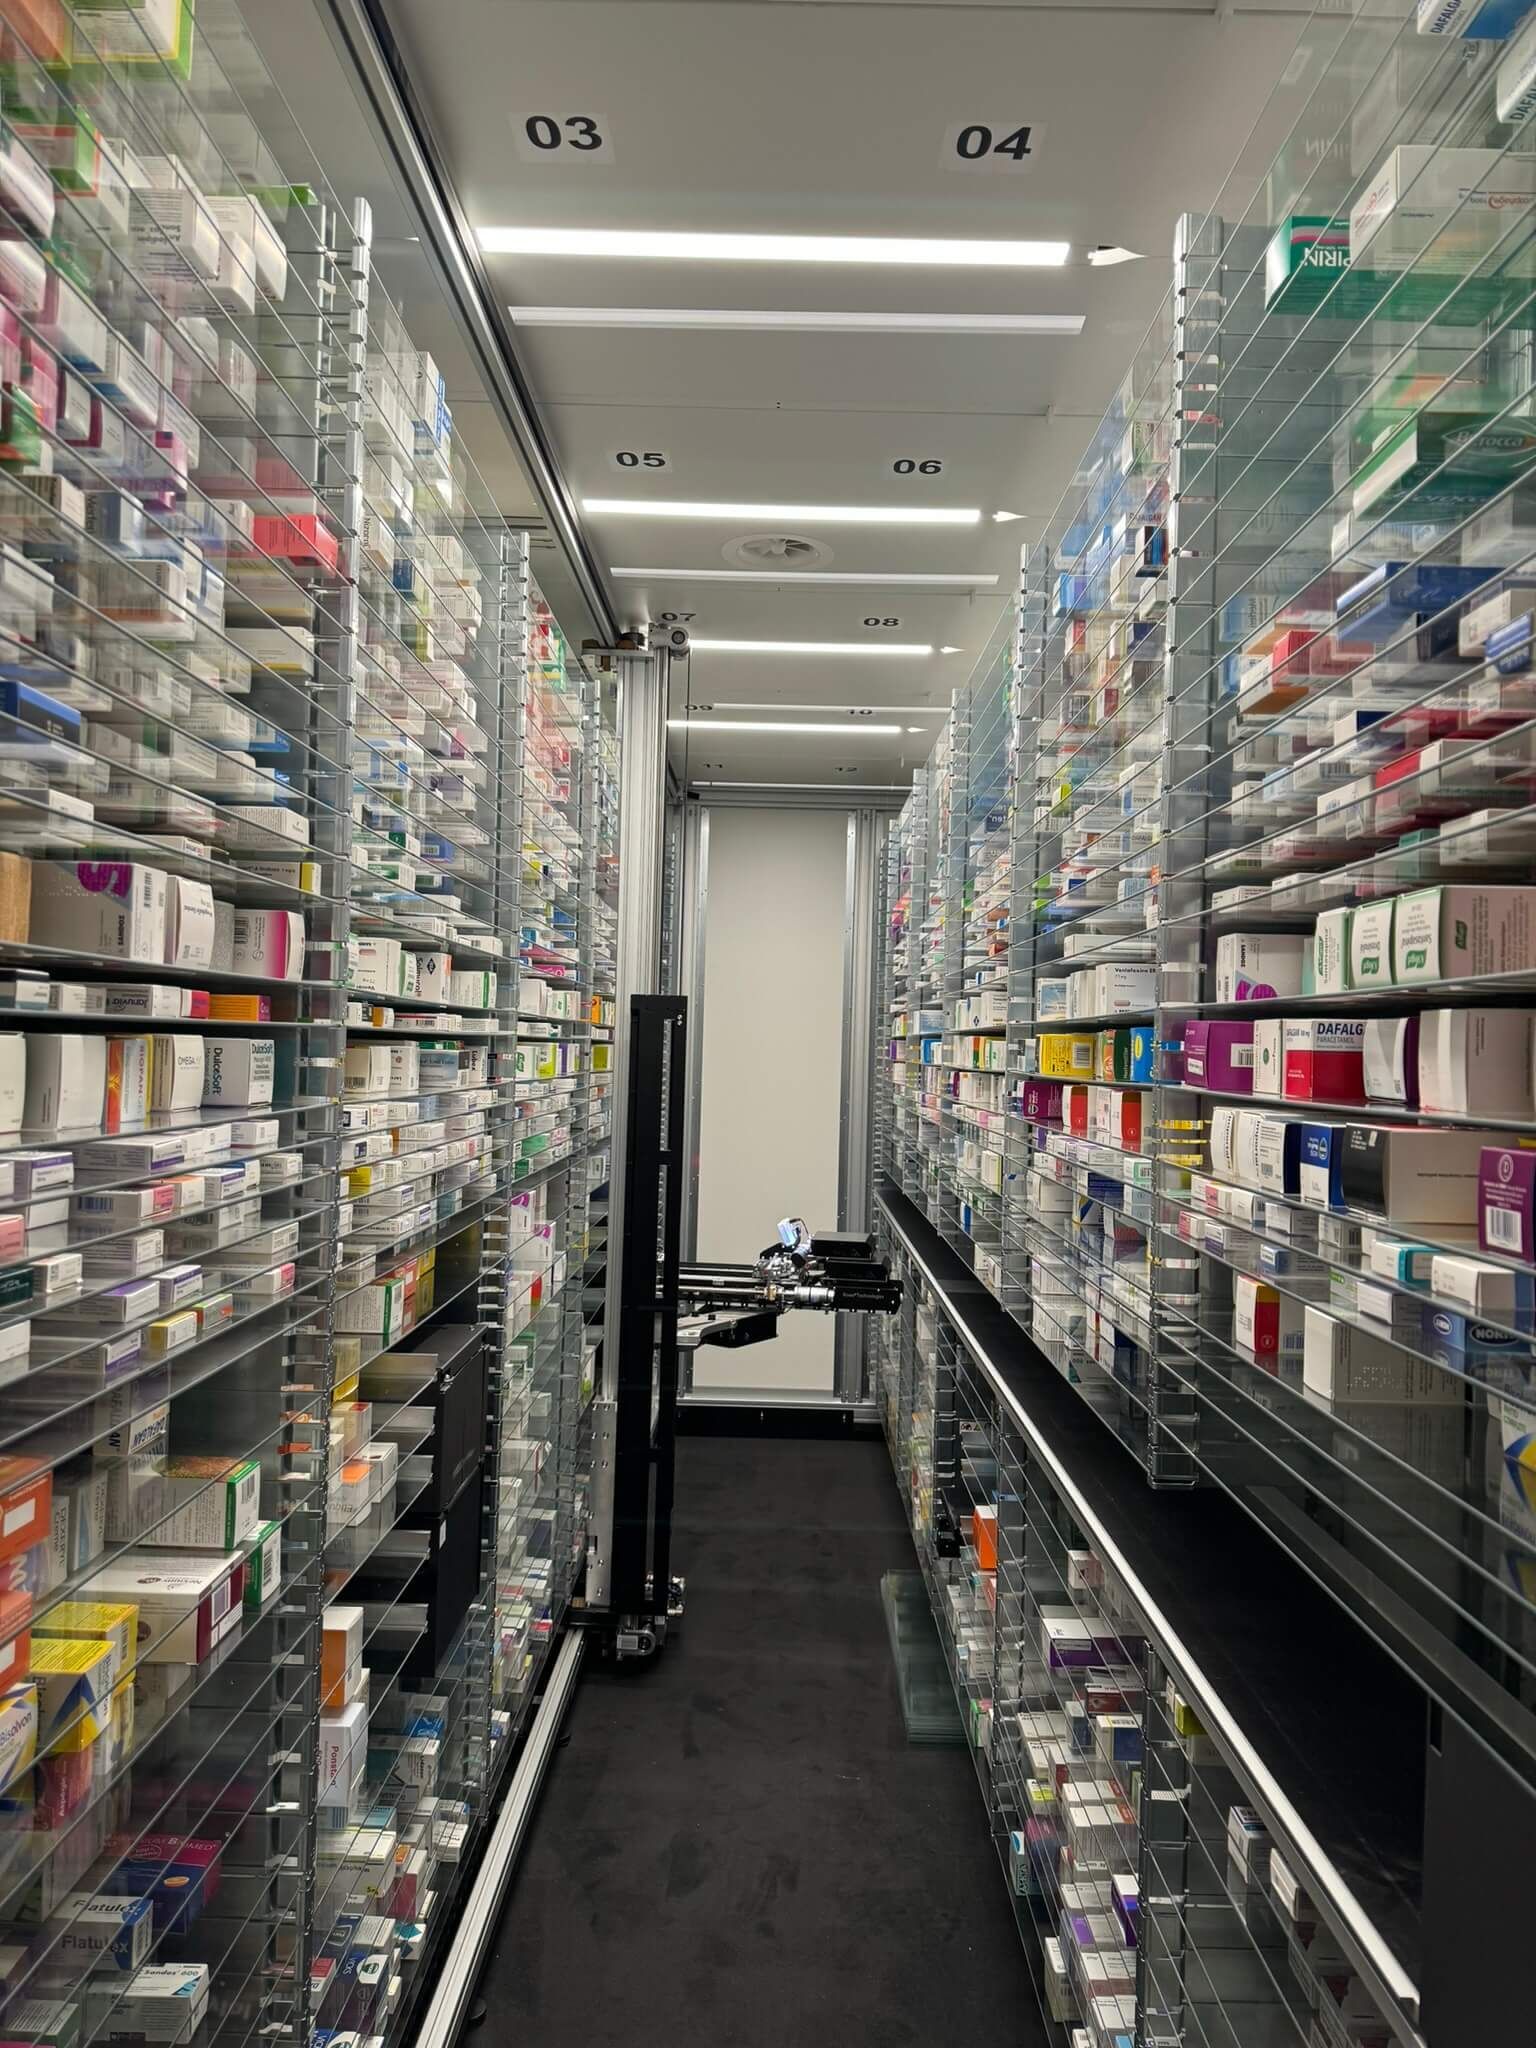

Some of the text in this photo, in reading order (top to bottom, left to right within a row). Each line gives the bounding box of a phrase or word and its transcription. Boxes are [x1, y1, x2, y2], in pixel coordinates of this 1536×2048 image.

[525, 115, 603, 150] 03
[956, 125, 1032, 160] 04
[615, 452, 667, 468] 05
[893, 459, 943, 475] 06
[661, 612, 697, 622] 07
[863, 617, 900, 627] 08
[112, 997, 148, 1010] Januvia
[1317, 1022, 1364, 1036] DAFALG
[212, 1047, 223, 1096] DulceSoft
